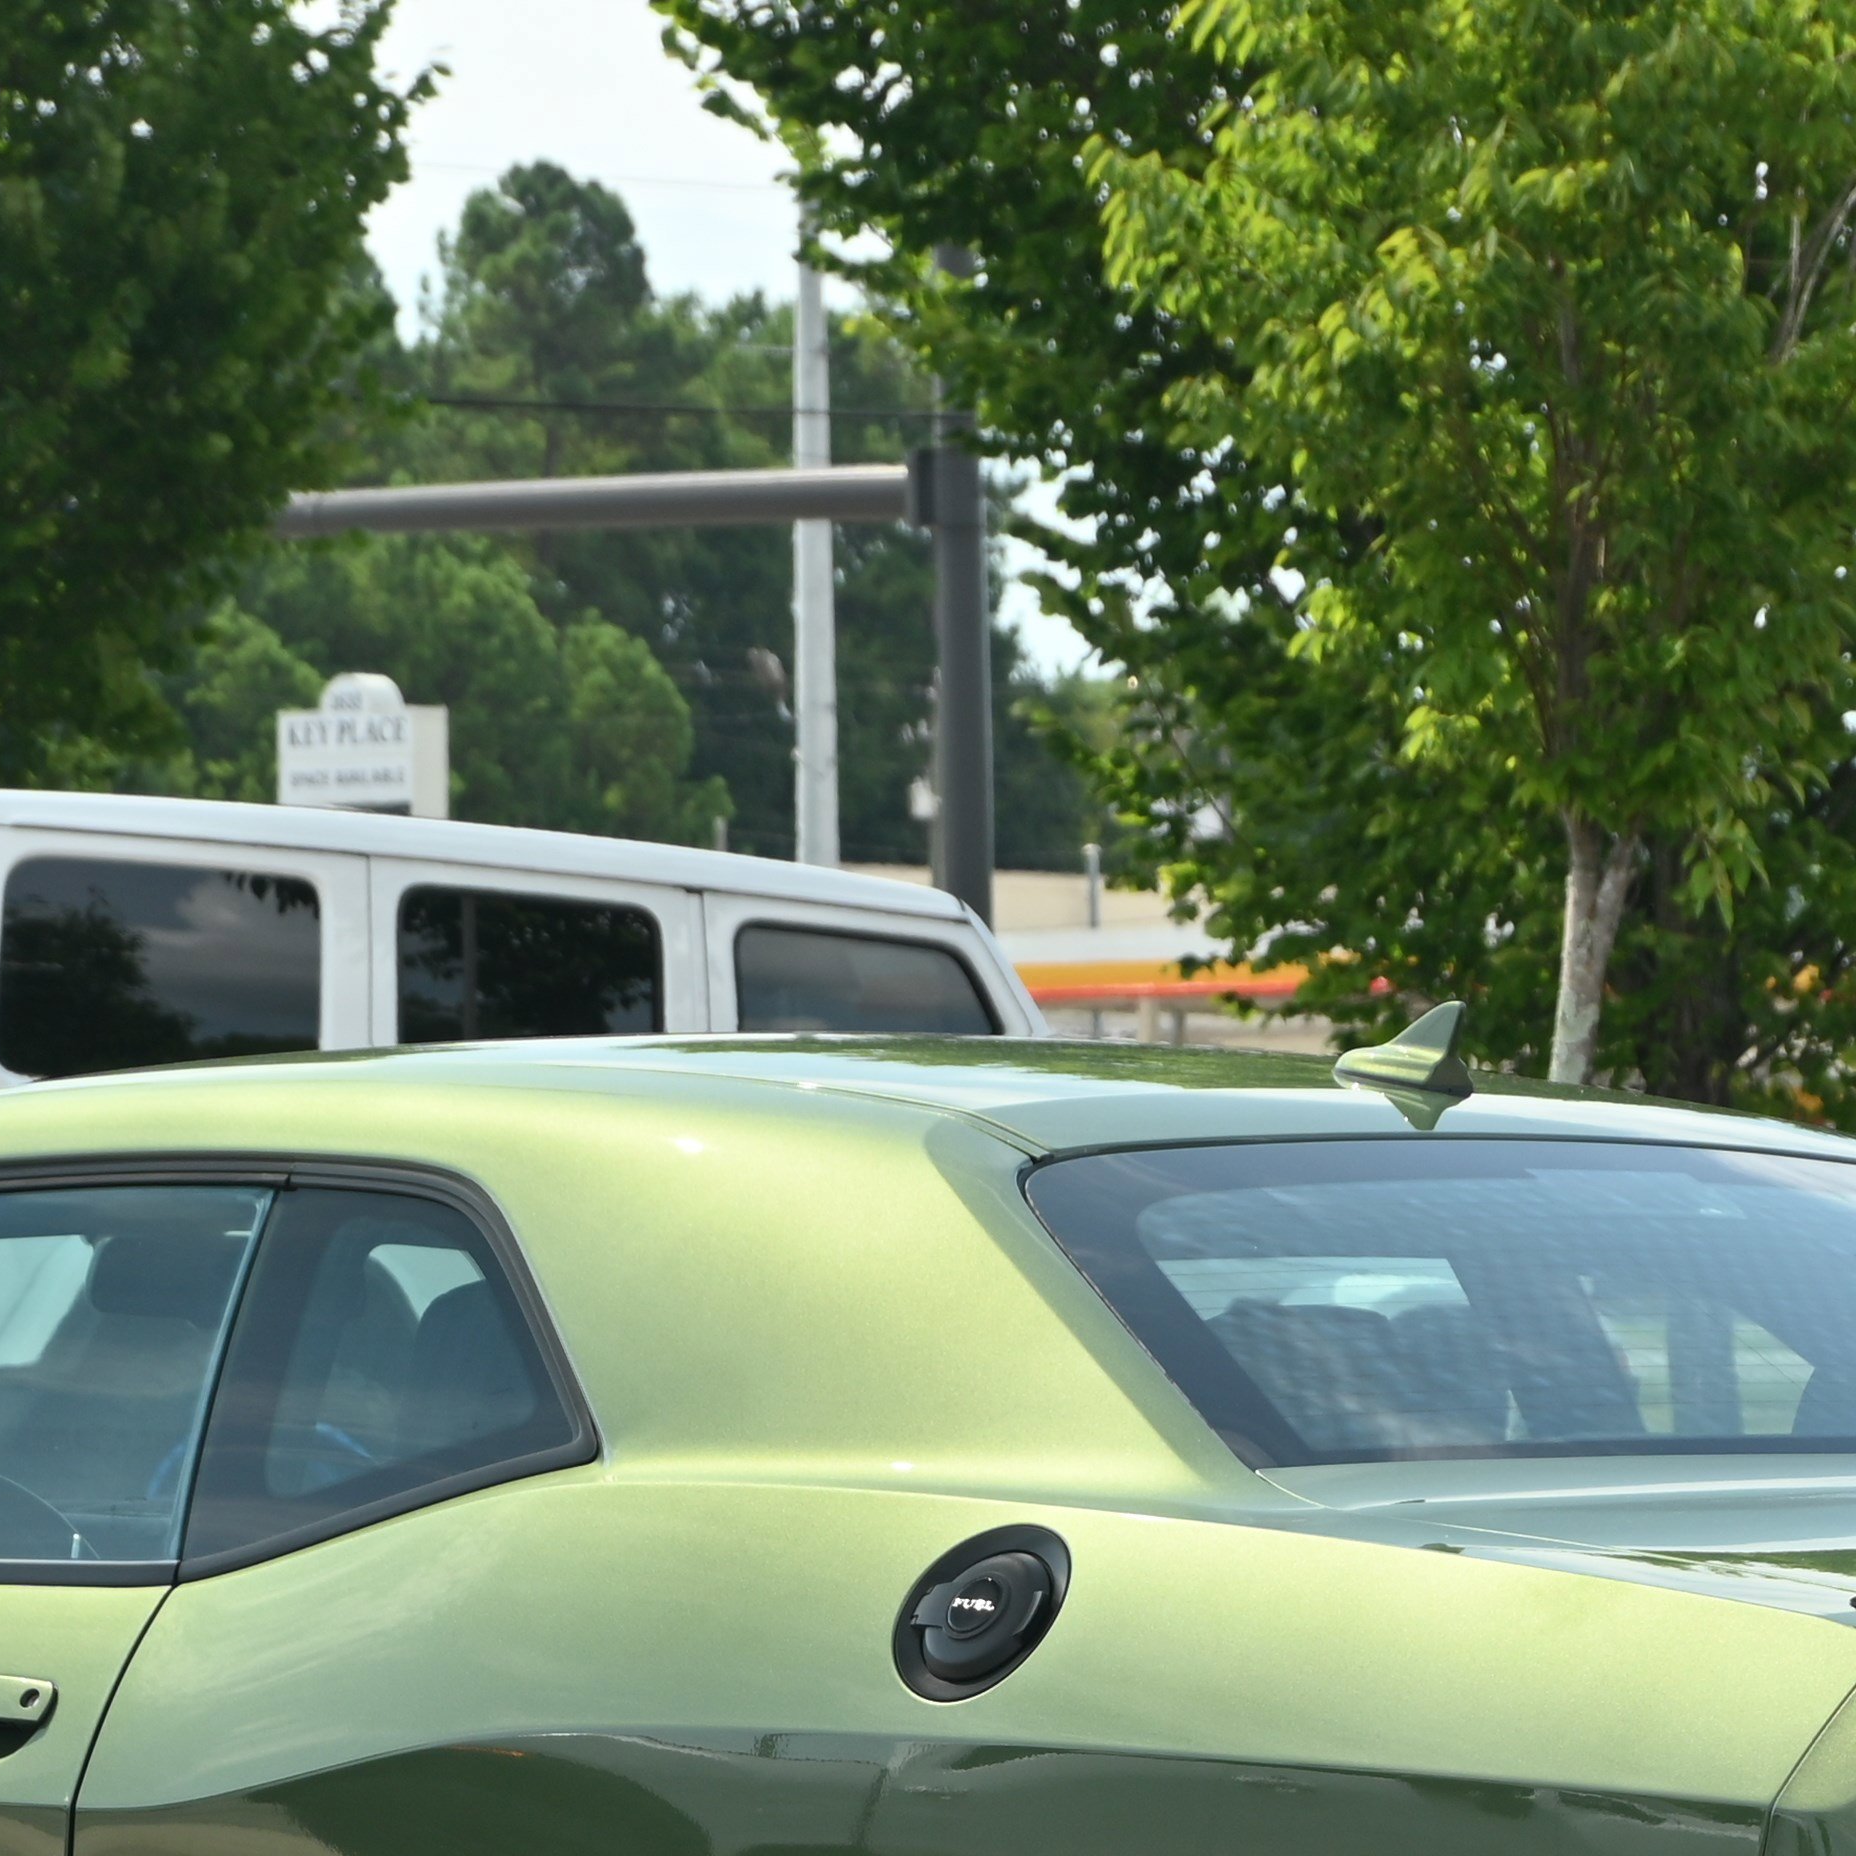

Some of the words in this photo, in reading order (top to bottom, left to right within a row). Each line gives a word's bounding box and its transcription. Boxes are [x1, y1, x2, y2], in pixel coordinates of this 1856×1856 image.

[287, 719, 329, 747] KEY
[335, 714, 407, 744] PLACE
[951, 1597, 996, 1612] FUEL
